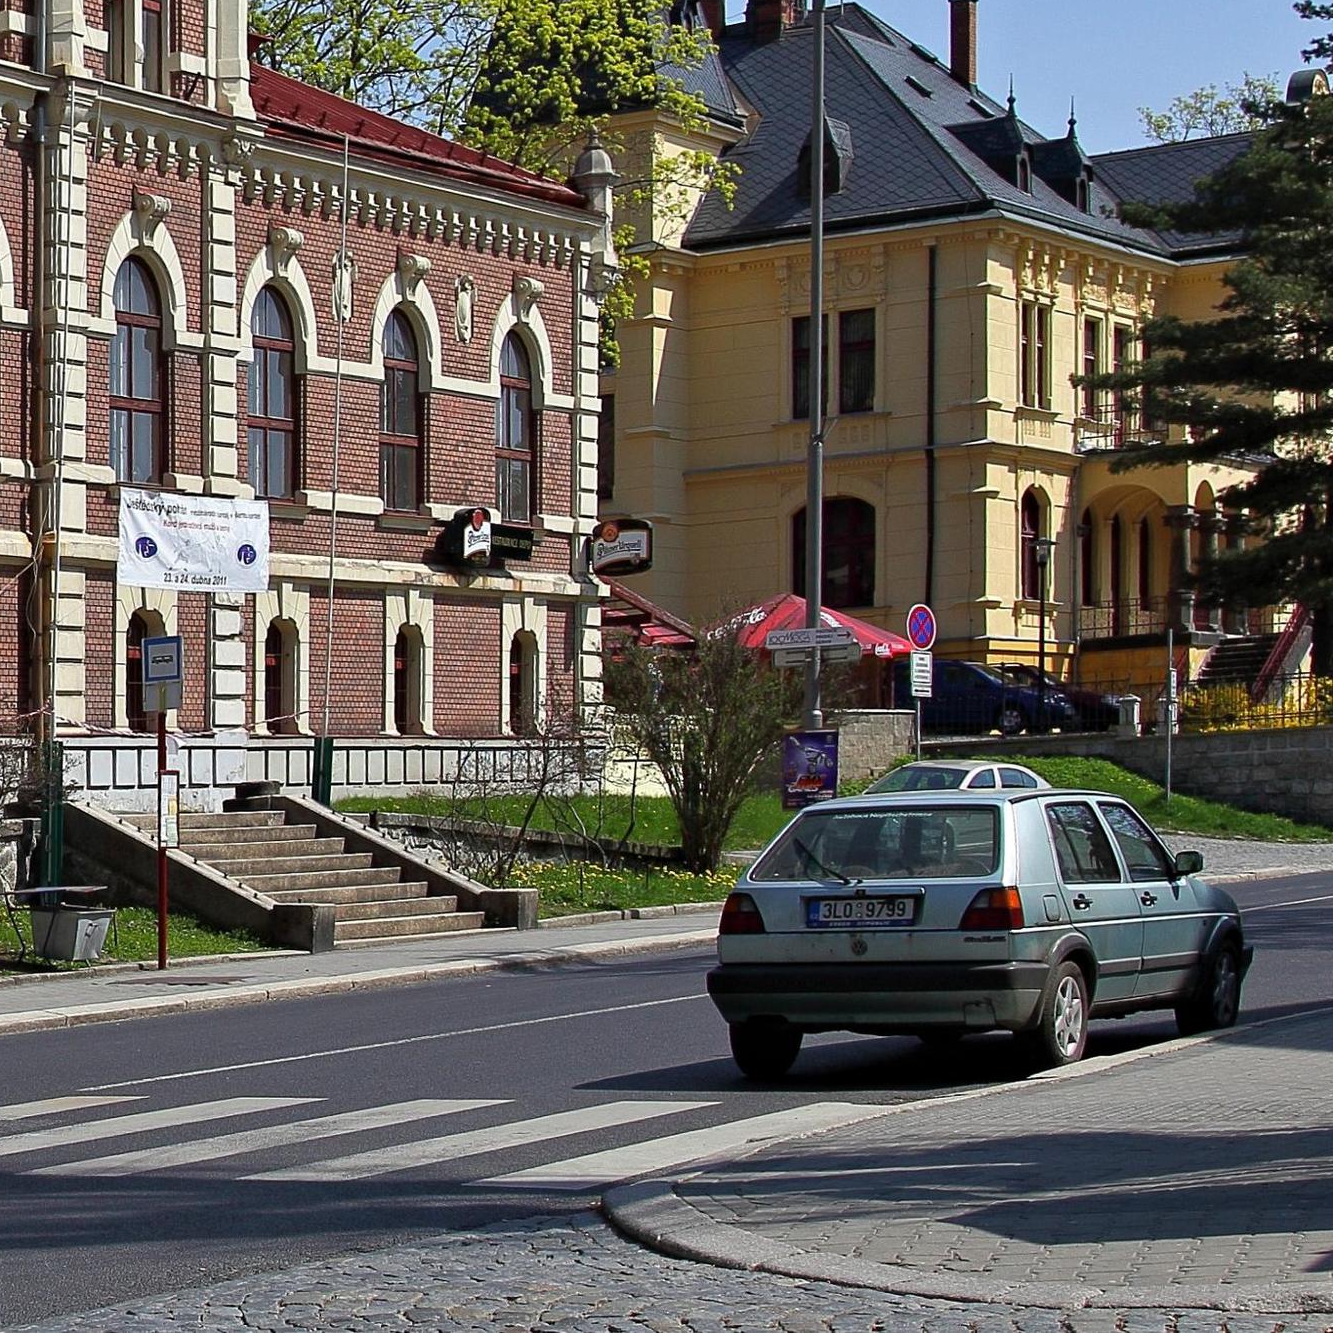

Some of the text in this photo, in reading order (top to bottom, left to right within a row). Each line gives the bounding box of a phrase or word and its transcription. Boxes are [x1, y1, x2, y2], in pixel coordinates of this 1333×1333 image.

[191, 574, 211, 585] dubna
[212, 575, 227, 586] 2011
[865, 900, 906, 918] 9799
